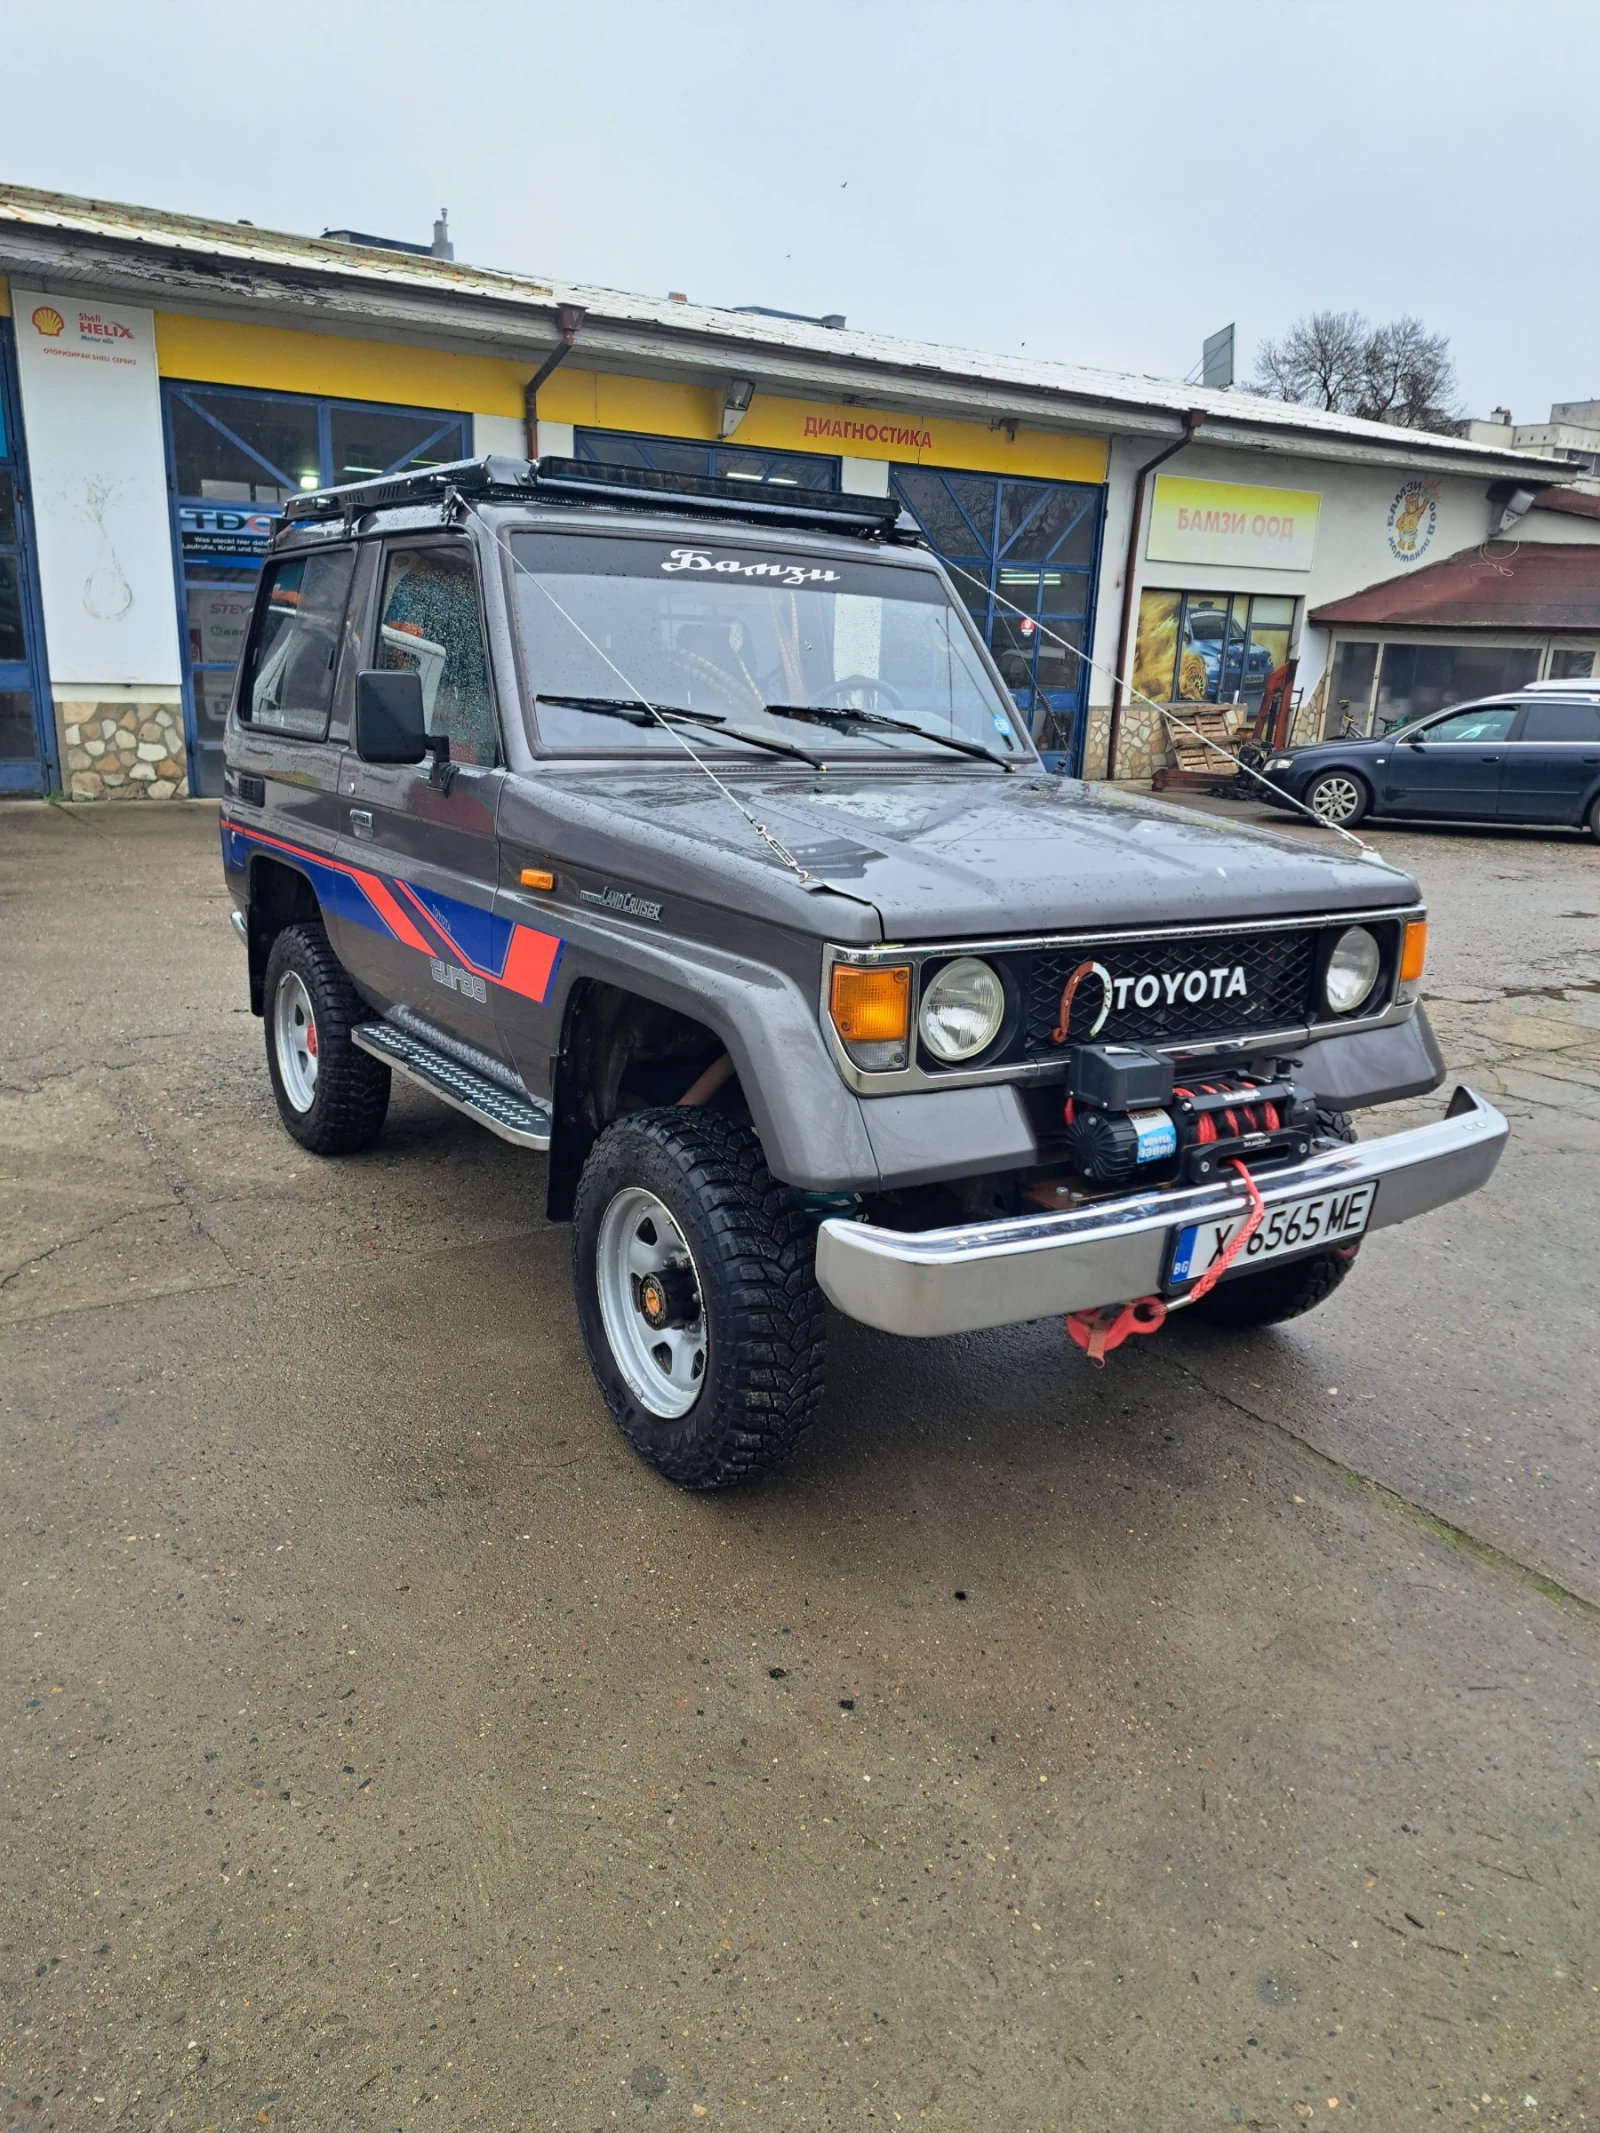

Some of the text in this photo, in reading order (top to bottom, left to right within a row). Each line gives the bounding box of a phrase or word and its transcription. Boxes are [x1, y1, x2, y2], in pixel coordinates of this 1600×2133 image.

[78, 312, 101, 323] Shell
[80, 322, 134, 339] HELIX
[803, 416, 932, 449] ДИАГНОСТИКА
[1177, 508, 1295, 543] БАМЗИ ООД
[431, 903, 452, 934] TOYOTA
[1113, 966, 1247, 1010] TOYOTA
[1246, 1201, 1324, 1255] 6565
[1325, 1189, 1368, 1236] ME
[1173, 1260, 1190, 1276] BG
